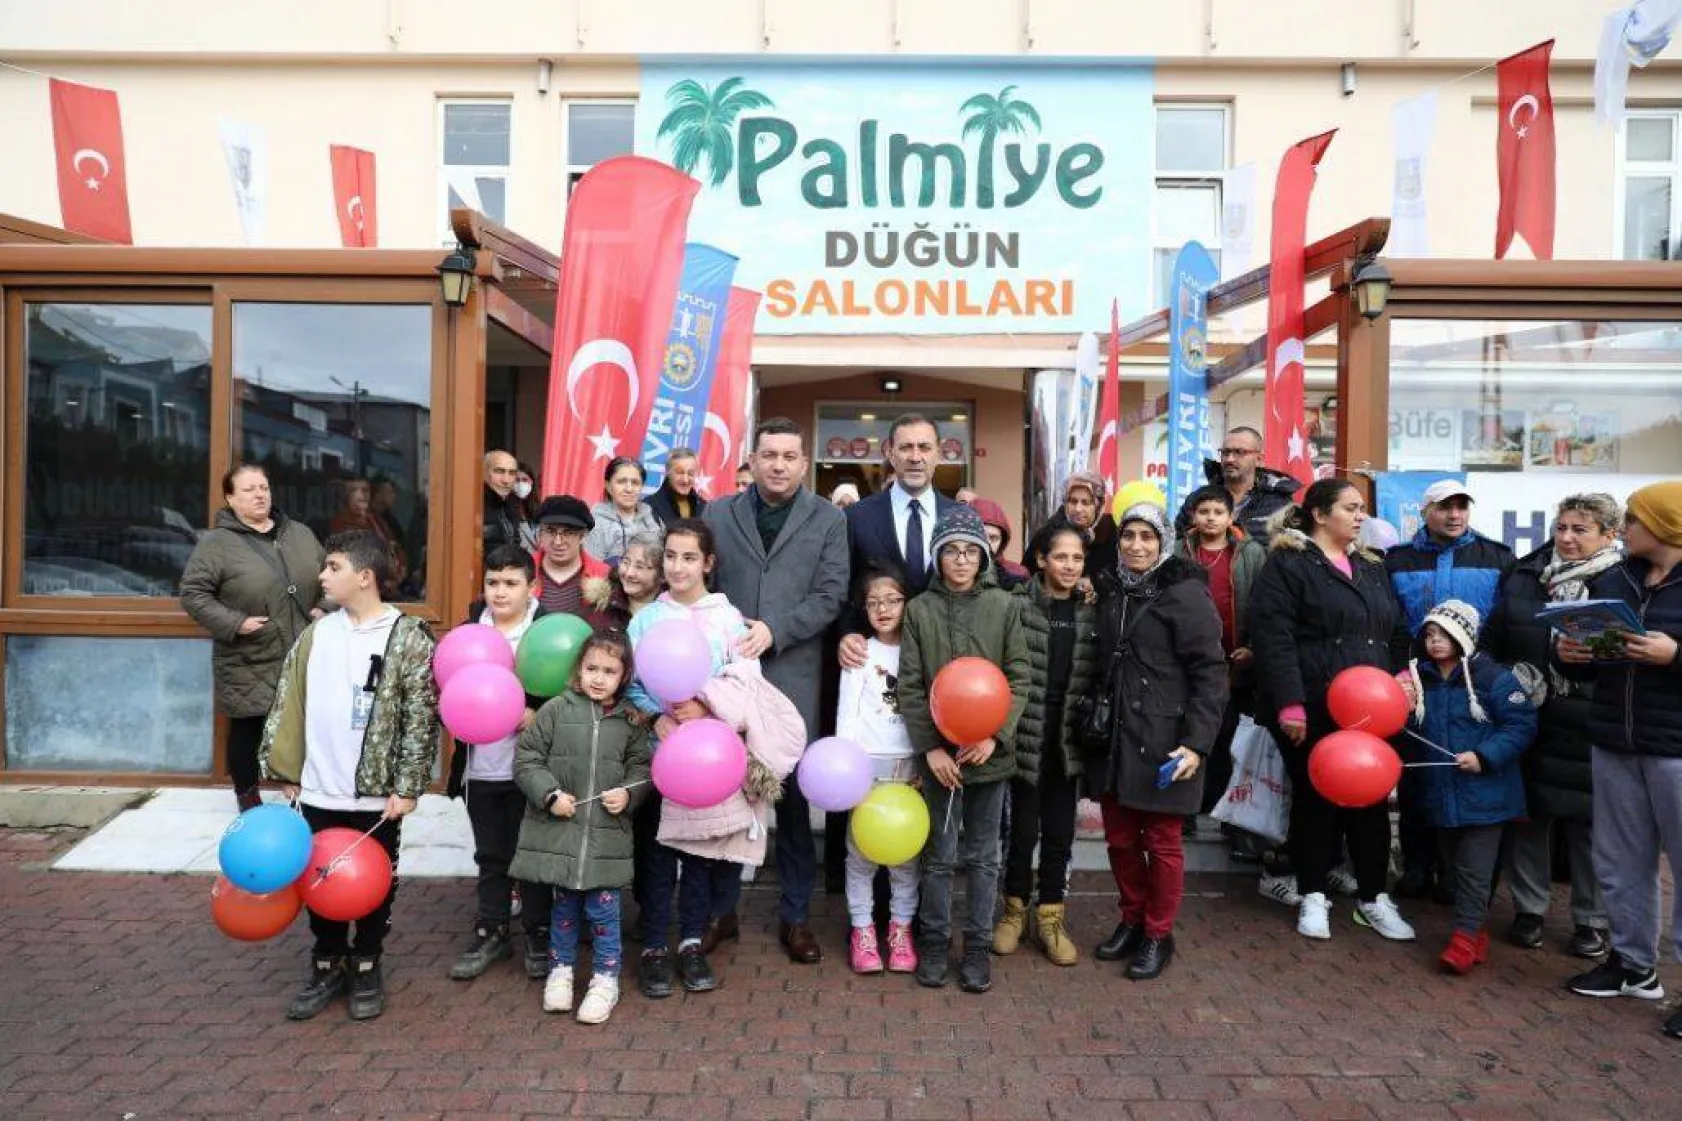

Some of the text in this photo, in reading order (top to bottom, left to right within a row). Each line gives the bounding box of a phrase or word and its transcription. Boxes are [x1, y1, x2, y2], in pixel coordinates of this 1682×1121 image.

[737, 85, 1105, 210] Palmiye
[825, 222, 1019, 269] DÜĞÜN
[765, 278, 1074, 317] SALONLARI
[1147, 462, 1169, 478] PA
[1502, 510, 1546, 560] H
